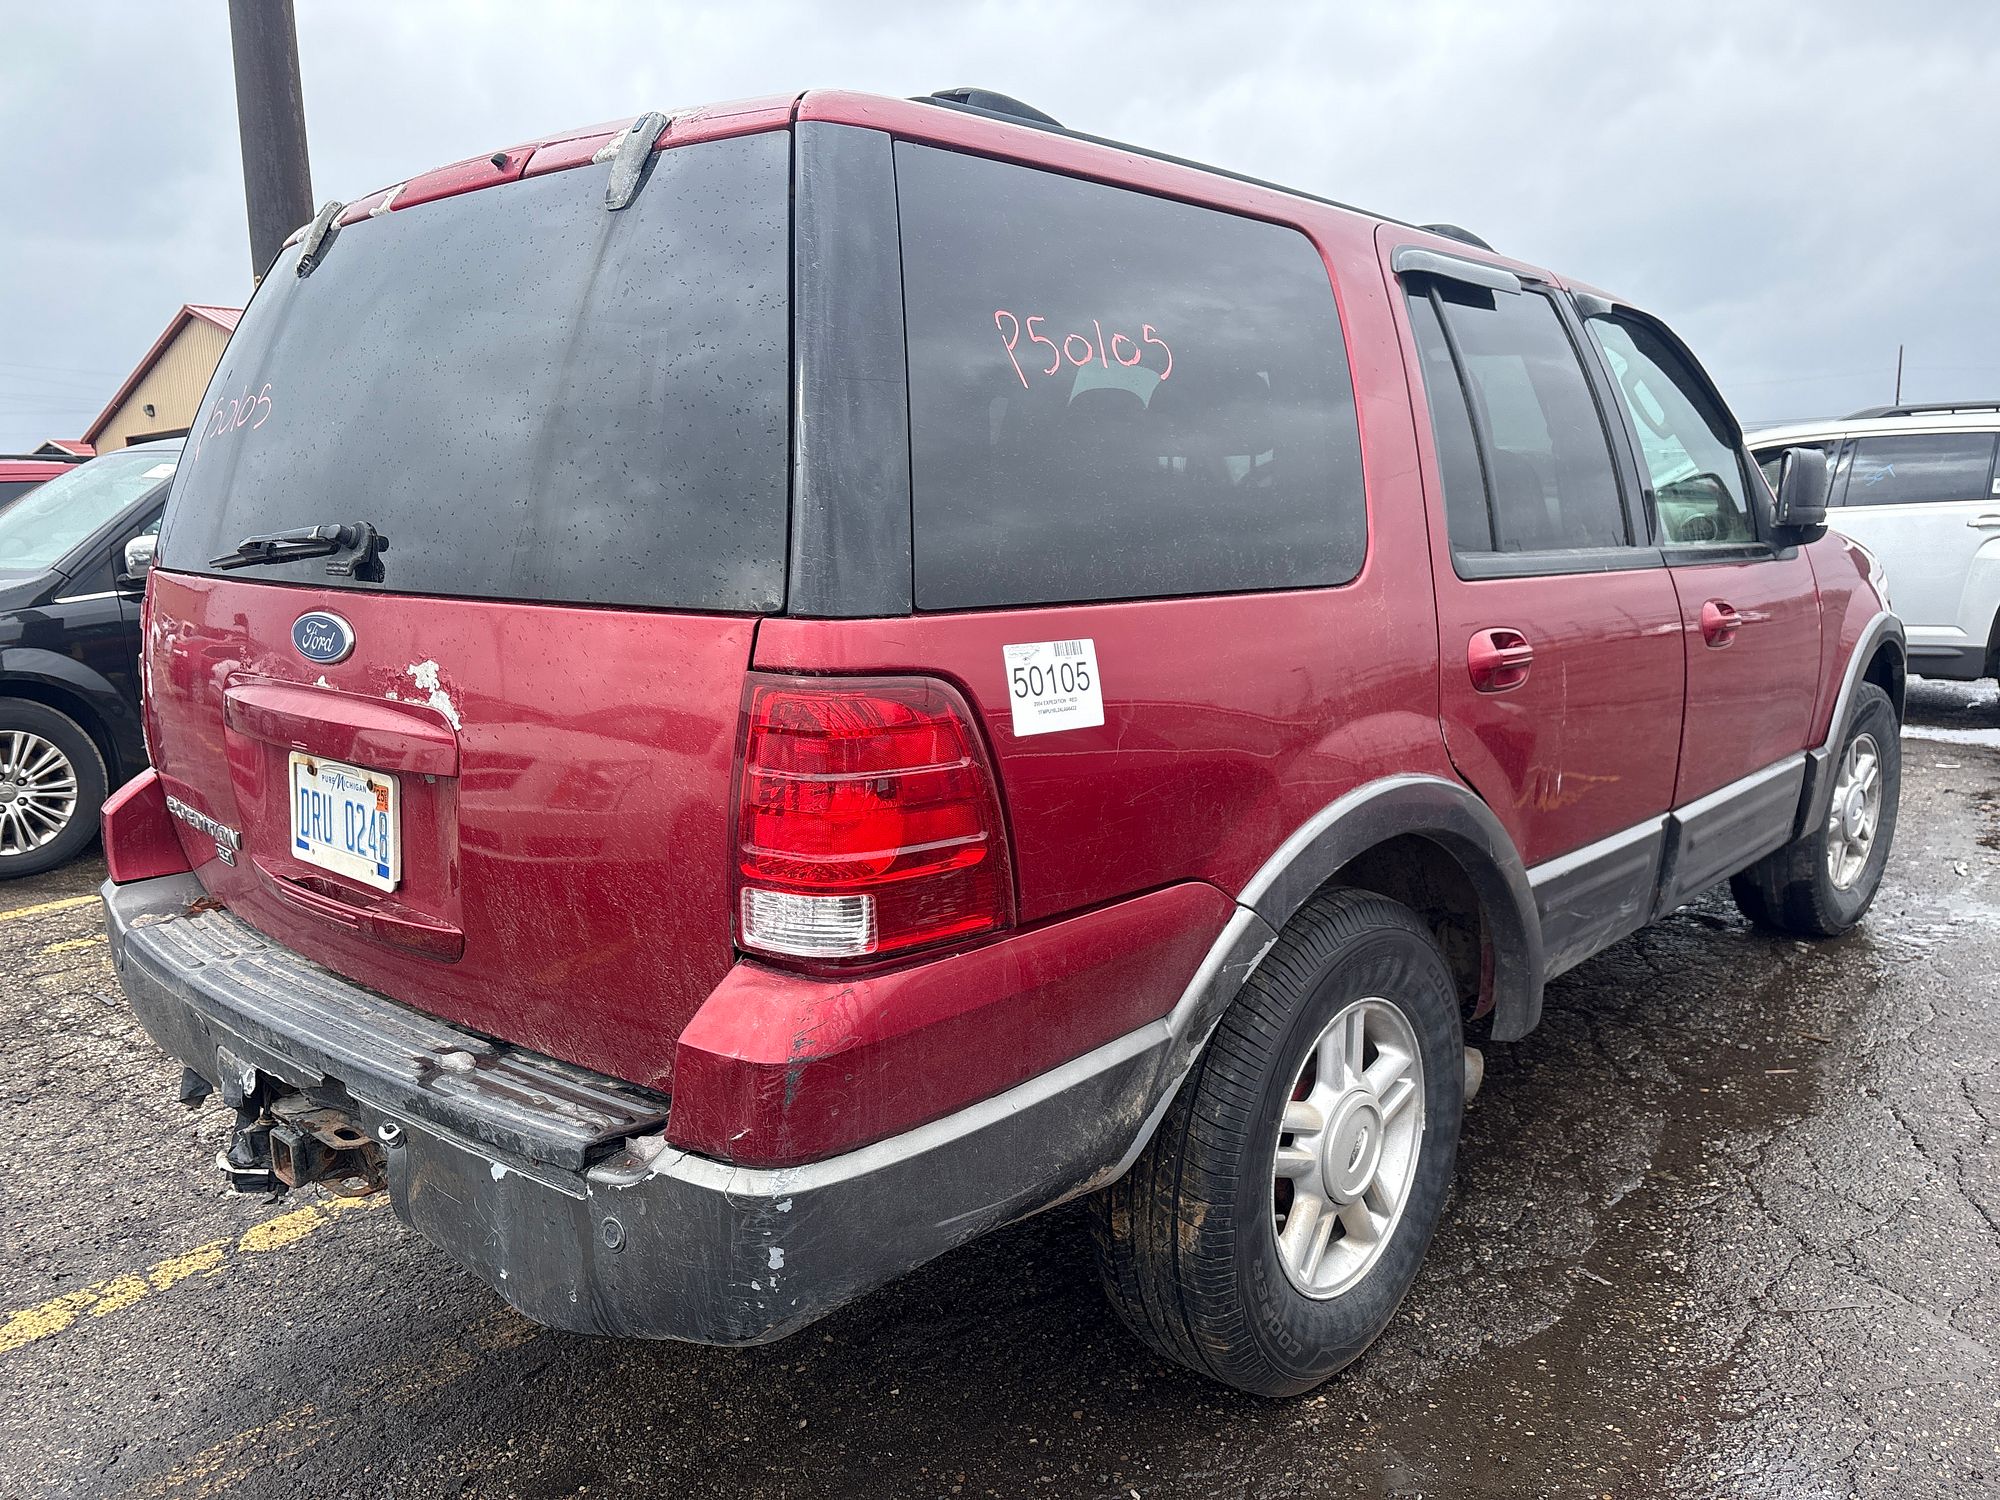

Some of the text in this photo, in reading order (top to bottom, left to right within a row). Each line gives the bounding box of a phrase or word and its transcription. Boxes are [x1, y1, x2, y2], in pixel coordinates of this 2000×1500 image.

[993, 310, 1173, 389] P50105
[302, 620, 336, 652] Ford
[1013, 662, 1090, 698] 50105
[331, 773, 367, 794] MICHIGAN
[166, 795, 242, 852] EXPEDITION
[301, 787, 389, 864] DRU 0248
